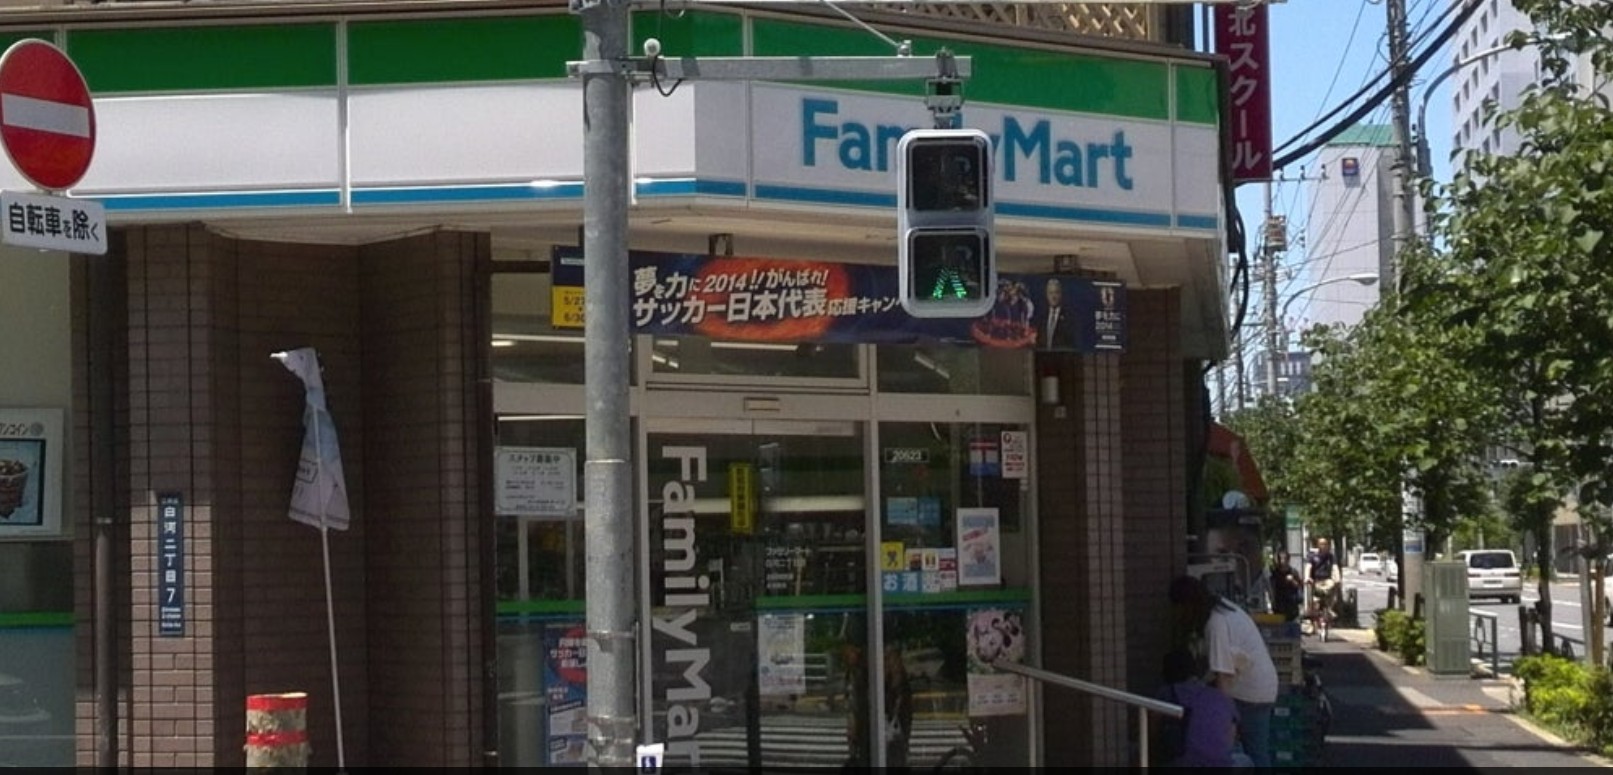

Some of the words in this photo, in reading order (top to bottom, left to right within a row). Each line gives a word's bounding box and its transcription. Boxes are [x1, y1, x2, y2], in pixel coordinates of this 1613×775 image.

[802, 97, 1133, 190] FaMart
[9, 202, 99, 242] 自転車を除く
